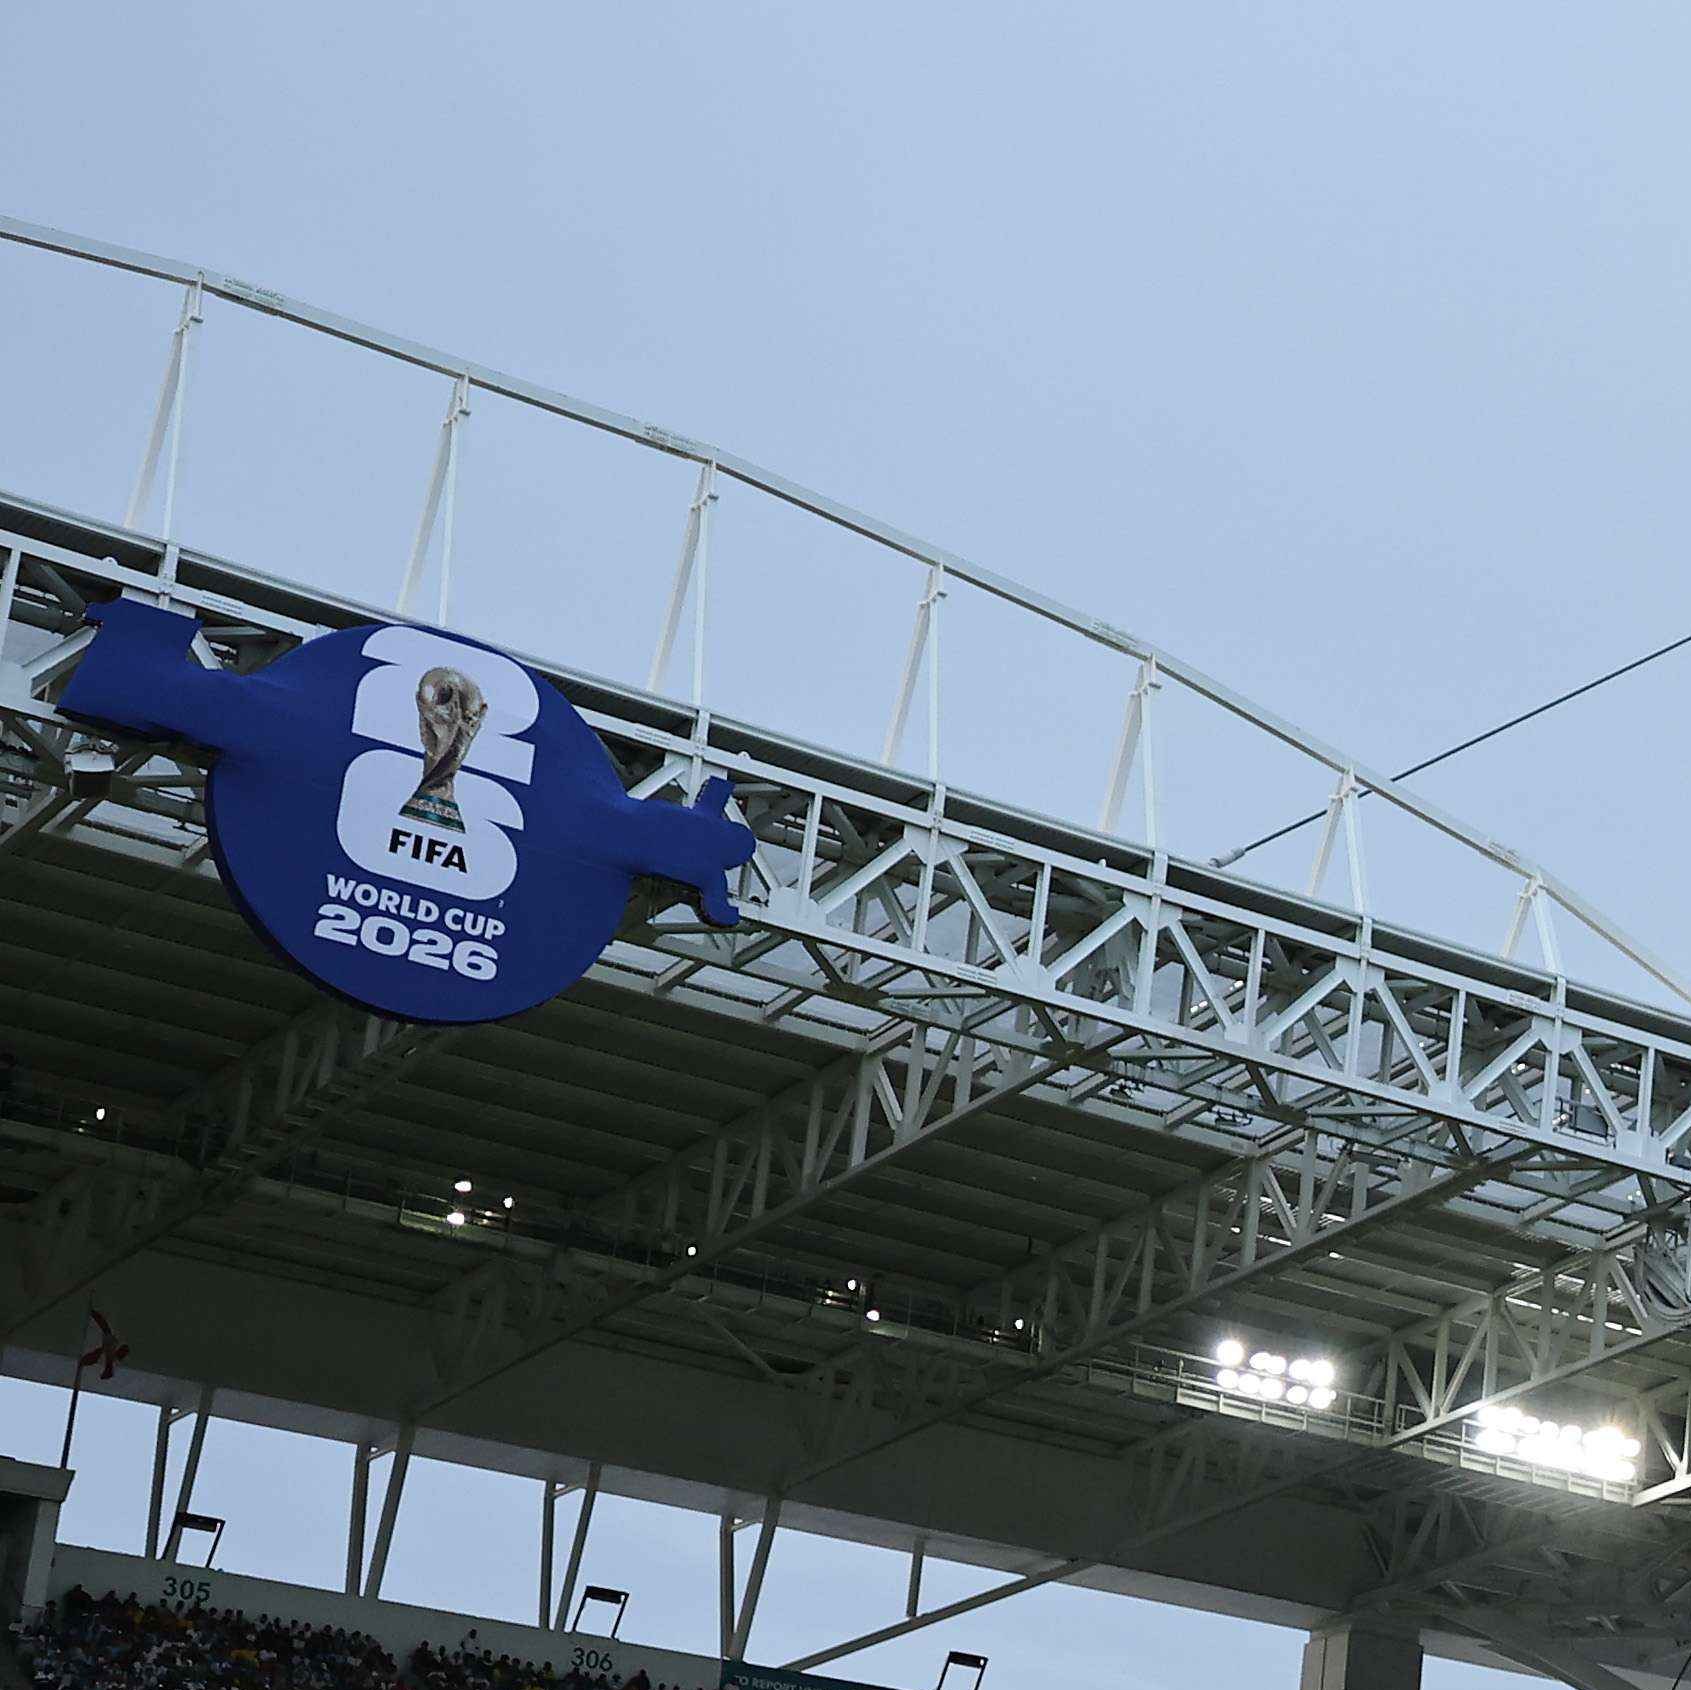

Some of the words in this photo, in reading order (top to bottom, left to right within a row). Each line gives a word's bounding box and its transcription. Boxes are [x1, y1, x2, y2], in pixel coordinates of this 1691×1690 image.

[389, 828, 469, 874] FIFA
[325, 874, 440, 923] WORLD
[445, 907, 507, 941] CUP
[314, 903, 499, 982] 2026
[163, 1577, 211, 1603] 305
[571, 1647, 612, 1672] 306
